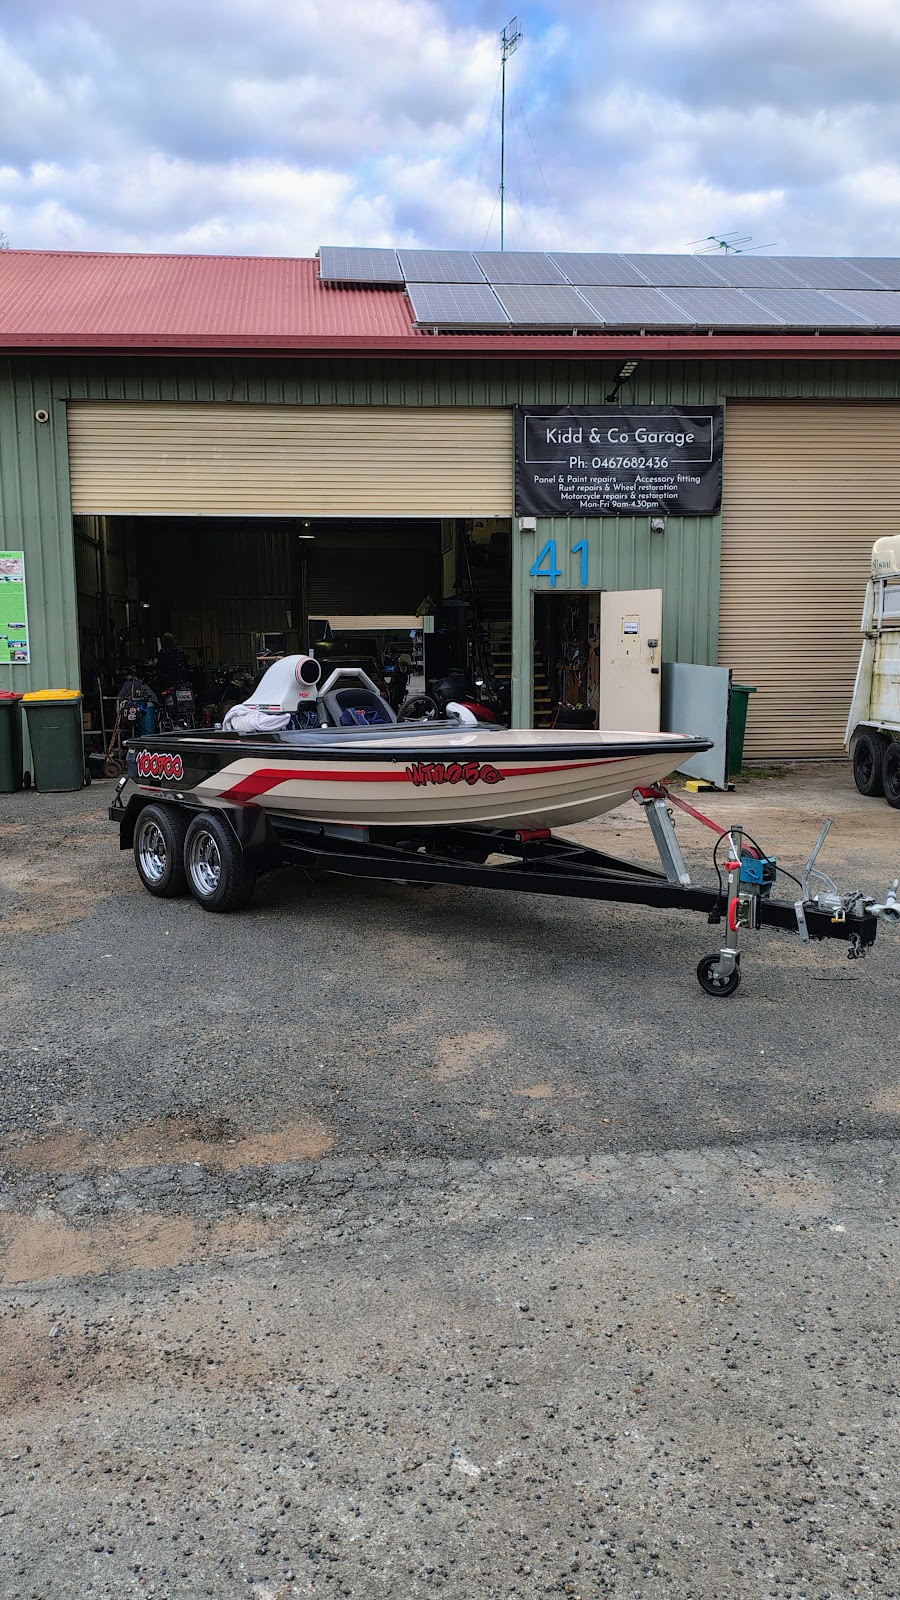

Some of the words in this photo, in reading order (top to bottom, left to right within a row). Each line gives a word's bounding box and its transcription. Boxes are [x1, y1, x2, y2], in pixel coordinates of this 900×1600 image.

[546, 427, 583, 444] Kidd
[589, 428, 601, 444] &
[607, 428, 629, 444] Co
[635, 428, 695, 447] Garage
[569, 456, 588, 469] Ph:
[592, 457, 669, 469] 0467682436
[534, 475, 556, 483] Panel
[558, 475, 565, 483] &
[567, 474, 588, 483] Paint
[590, 475, 617, 484] repairs
[635, 474, 675, 484] Accessory
[677, 473, 701, 485] fitting
[558, 484, 575, 492] Rust
[577, 484, 602, 493] repairs
[604, 483, 611, 491] &
[613, 483, 637, 491] Wheel
[638, 483, 678, 491] restoration
[560, 492, 601, 501] Motorcycle
[603, 493, 628, 501] repairs
[630, 491, 636, 499] &
[580, 500, 610, 508] Mon-Fri
[612, 500, 659, 509] 9am-4.30pm
[530, 538, 588, 588] 41
[136, 749, 184, 780] VOODOO
